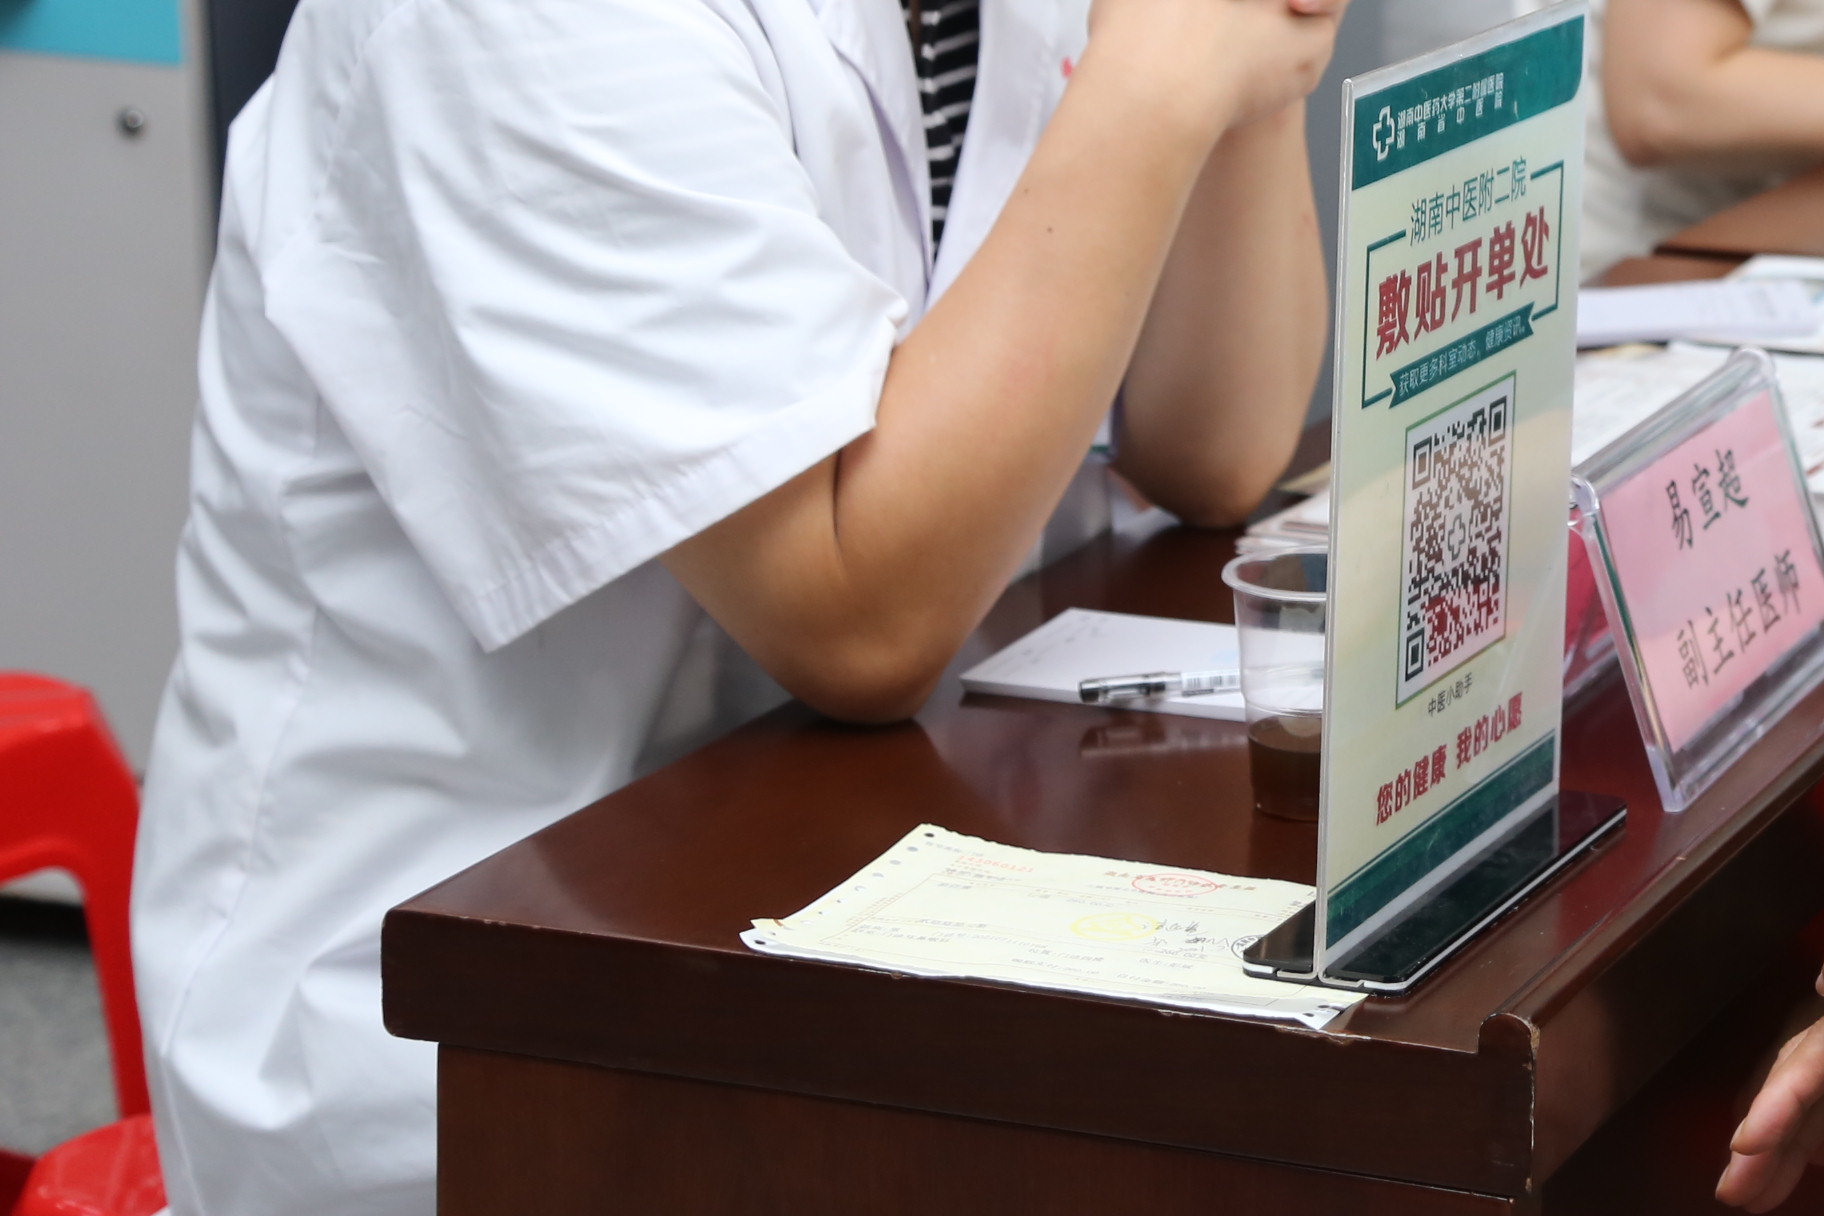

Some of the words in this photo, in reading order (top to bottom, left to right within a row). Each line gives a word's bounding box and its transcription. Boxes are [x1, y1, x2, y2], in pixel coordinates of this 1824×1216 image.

[1410, 156, 1527, 247] 湖南中医附二院
[1376, 205, 1550, 361] 敷贴开单处
[1676, 548, 1802, 690] 副主任医师
[1376, 744, 1447, 826] 您的健康
[1456, 691, 1523, 770] 我的心愿
[1428, 672, 1473, 717] 中医小助手
